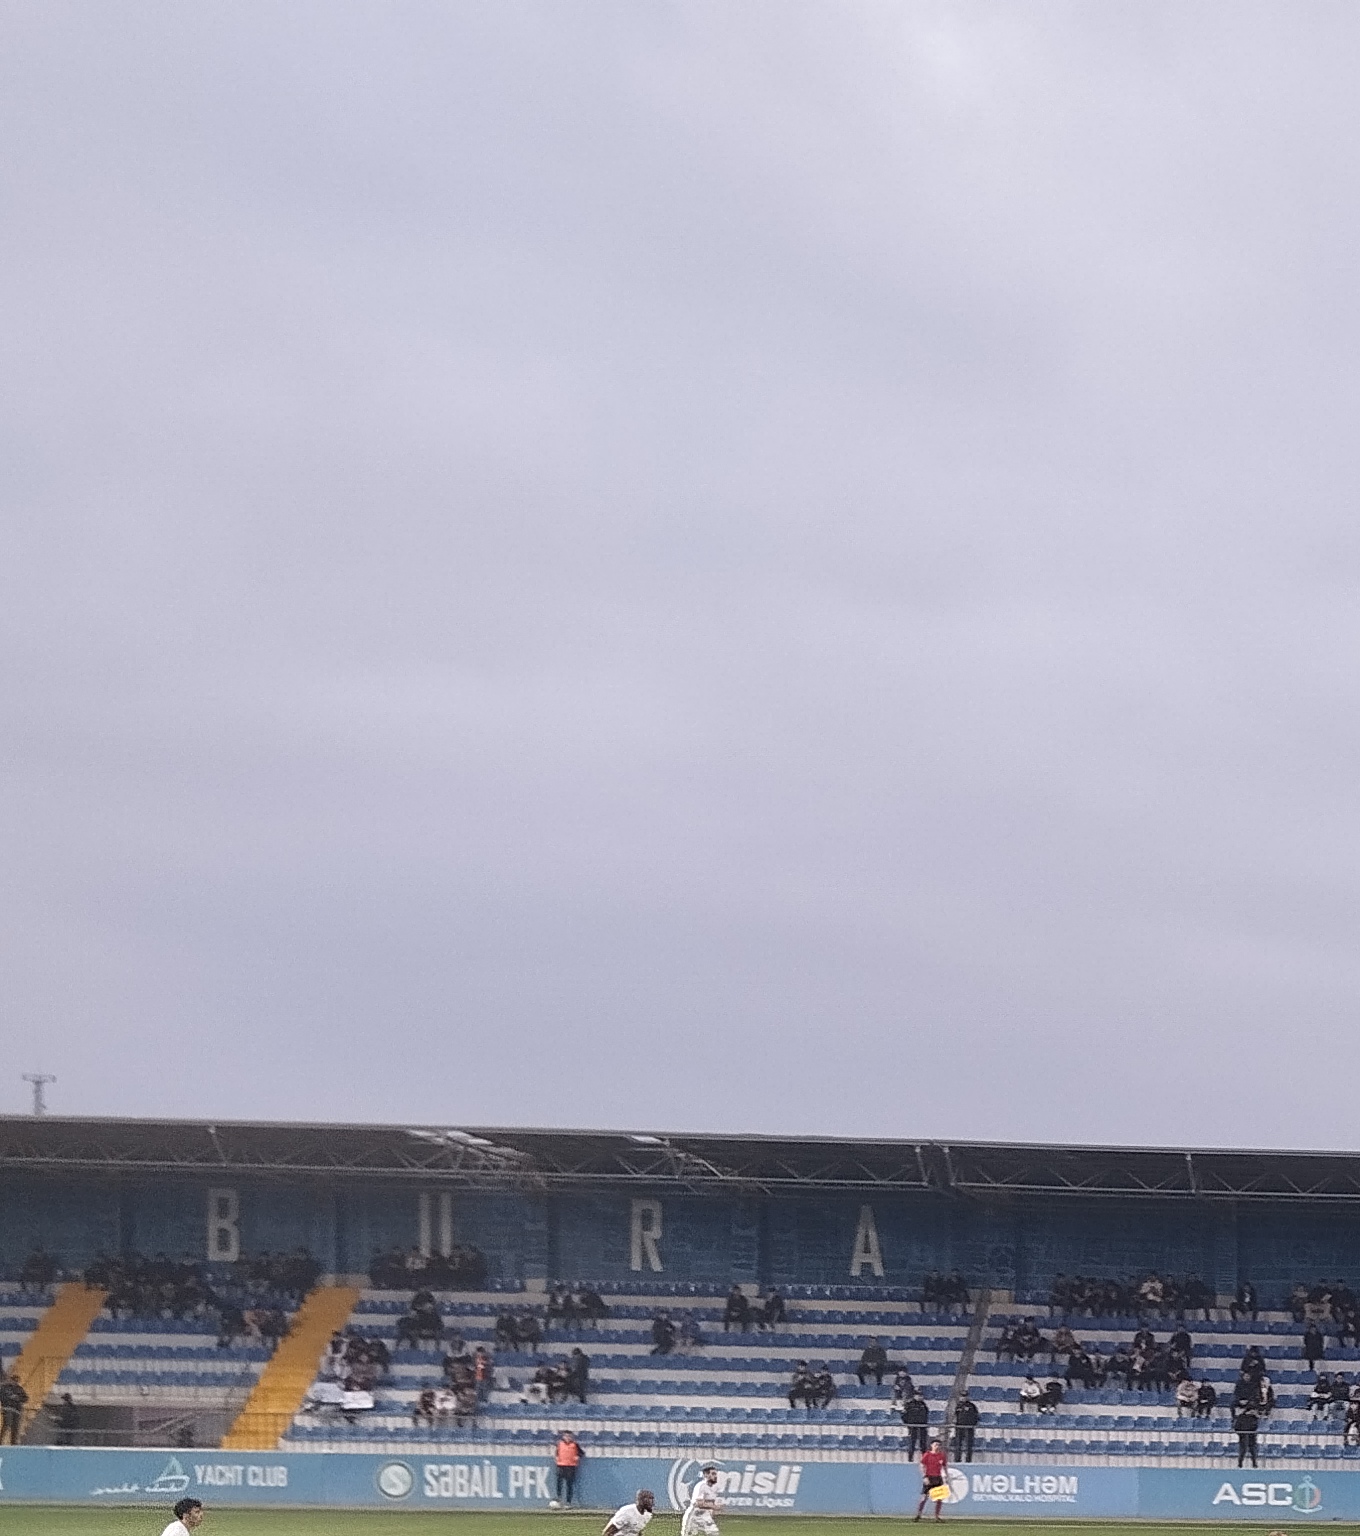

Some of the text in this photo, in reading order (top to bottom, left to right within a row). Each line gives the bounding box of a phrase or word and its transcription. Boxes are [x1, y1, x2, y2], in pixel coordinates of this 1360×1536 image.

[195, 1465, 288, 1487] YACHT CLUB
[509, 1465, 550, 1498] PFK
